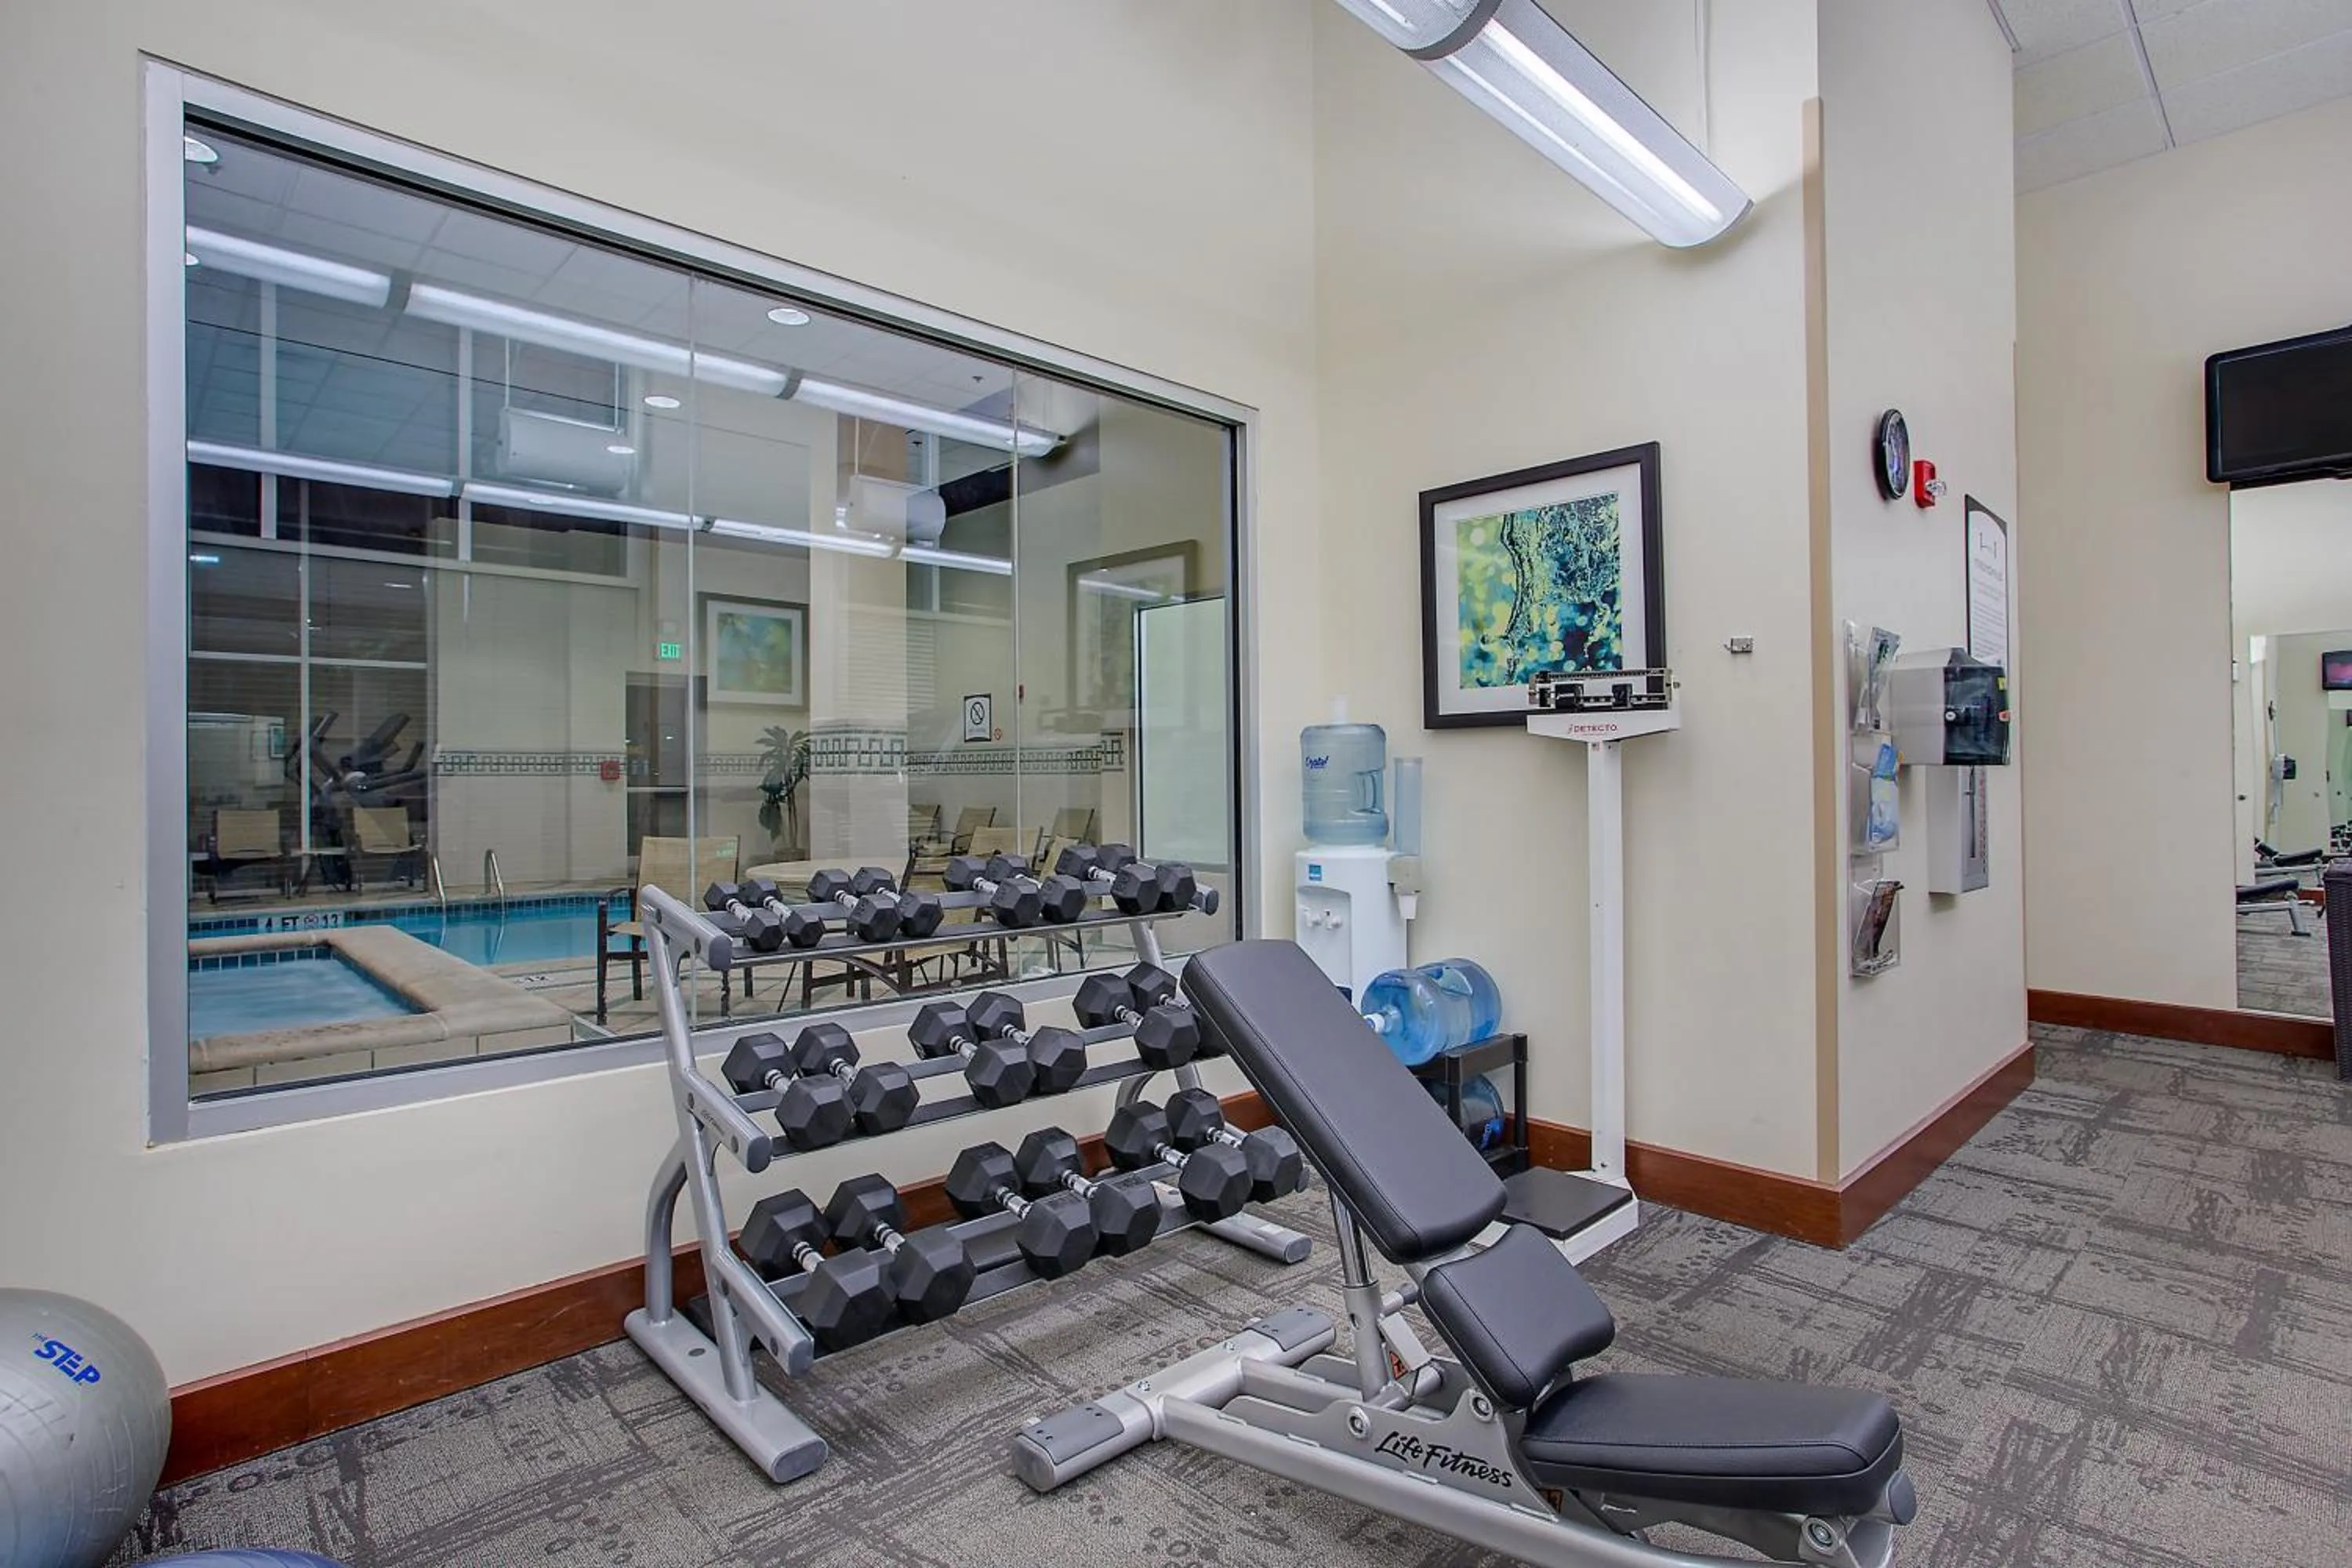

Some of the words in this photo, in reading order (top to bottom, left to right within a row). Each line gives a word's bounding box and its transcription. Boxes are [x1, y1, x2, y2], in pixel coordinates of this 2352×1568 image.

[660, 642, 681, 659] EXIT
[1573, 724, 1617, 733] DETECTO
[34, 1340, 100, 1384] STEP
[1374, 1431, 1424, 1464] Life
[1422, 1443, 1513, 1488] Fitness
